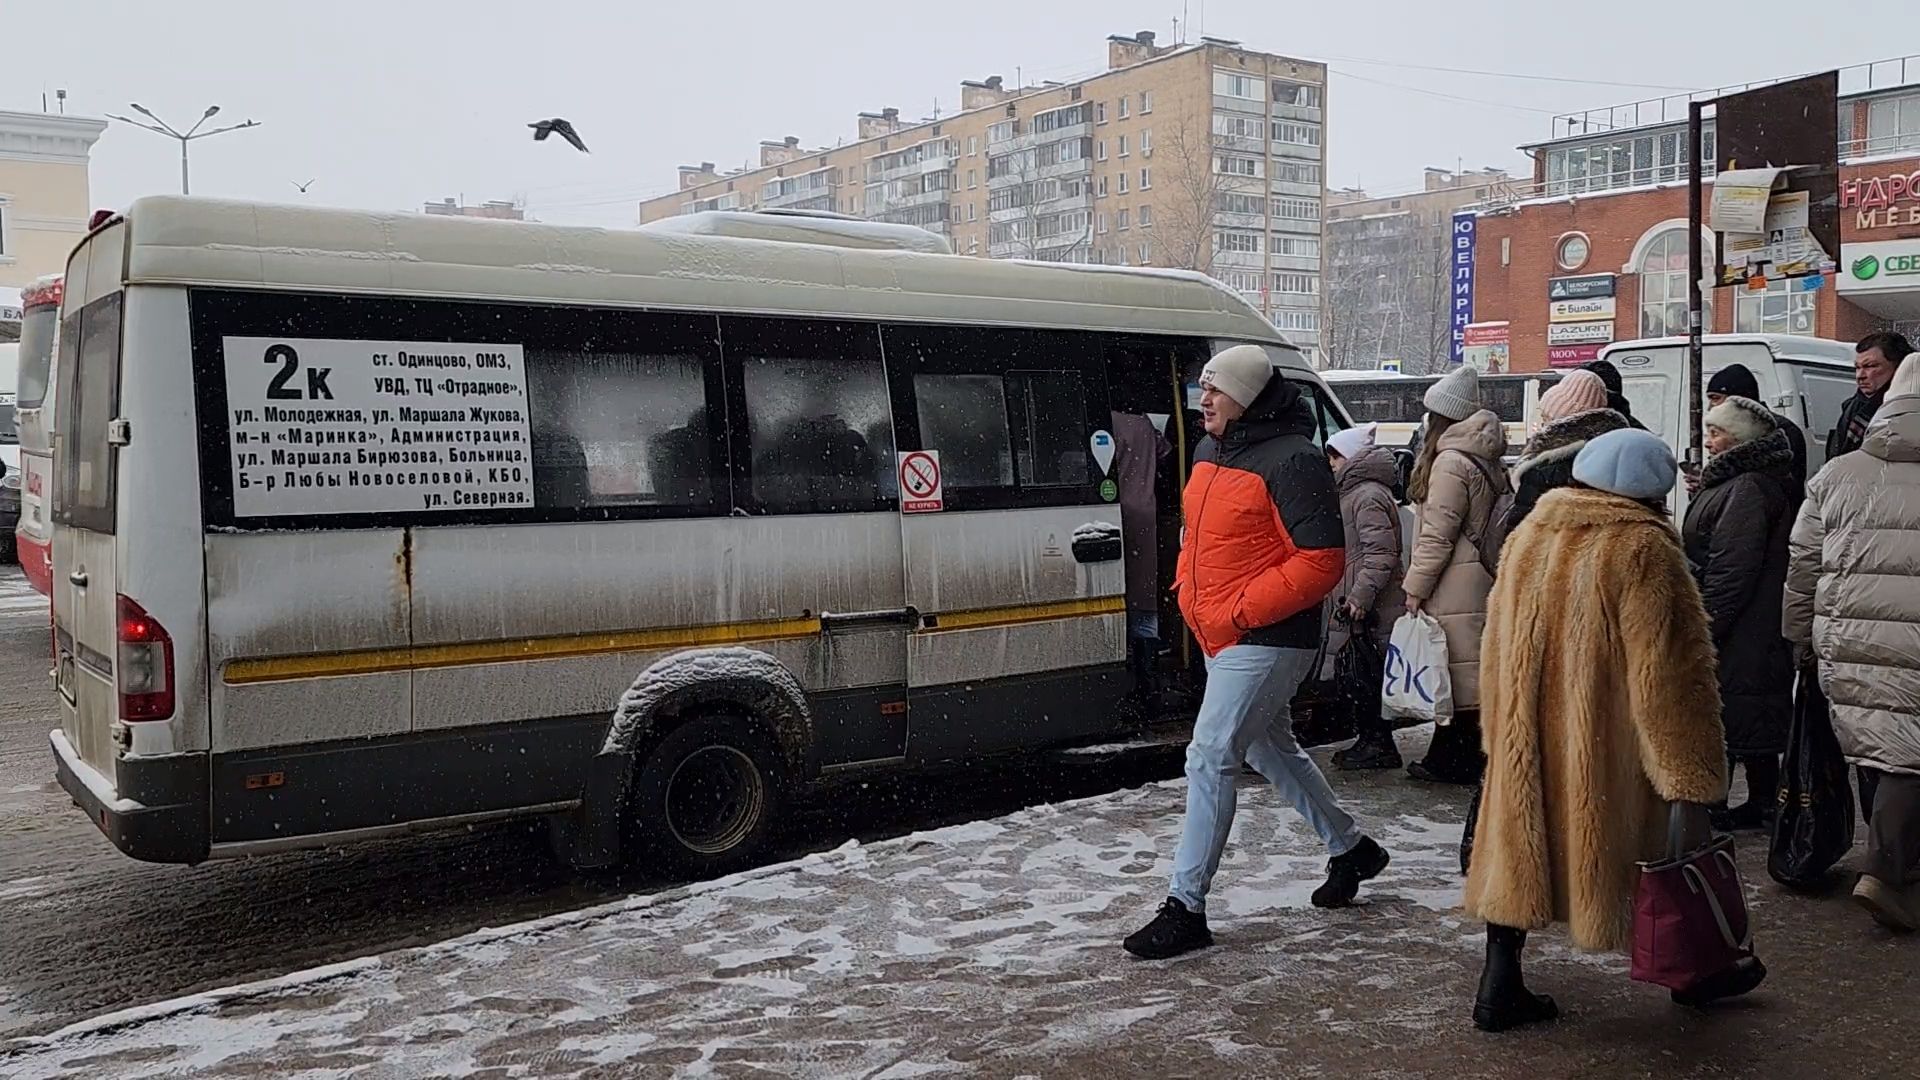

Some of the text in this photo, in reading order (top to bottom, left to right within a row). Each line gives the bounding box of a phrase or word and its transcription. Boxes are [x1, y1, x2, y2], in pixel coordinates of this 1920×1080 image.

[1568, 302, 1602, 313] Билайн
[1550, 325, 1611, 334] LAZURIT
[372, 351, 511, 370] ст. Одинцово, ОМЗ,
[1551, 349, 1577, 358] MOON
[374, 377, 523, 397] УВД, ТЦ «Отрадное»,
[234, 406, 525, 425] ул. Молодежная, ул. Маршала Жукова,
[277, 428, 384, 446] «Маринка»,
[391, 427, 527, 445] Администрация,
[237, 447, 528, 469] ул. Маршала Бирюзова, Больница,
[284, 471, 341, 487] Любы
[349, 469, 481, 486] Новоселовой,
[488, 467, 529, 484] КБО,
[424, 490, 530, 509] ул. Северная.
